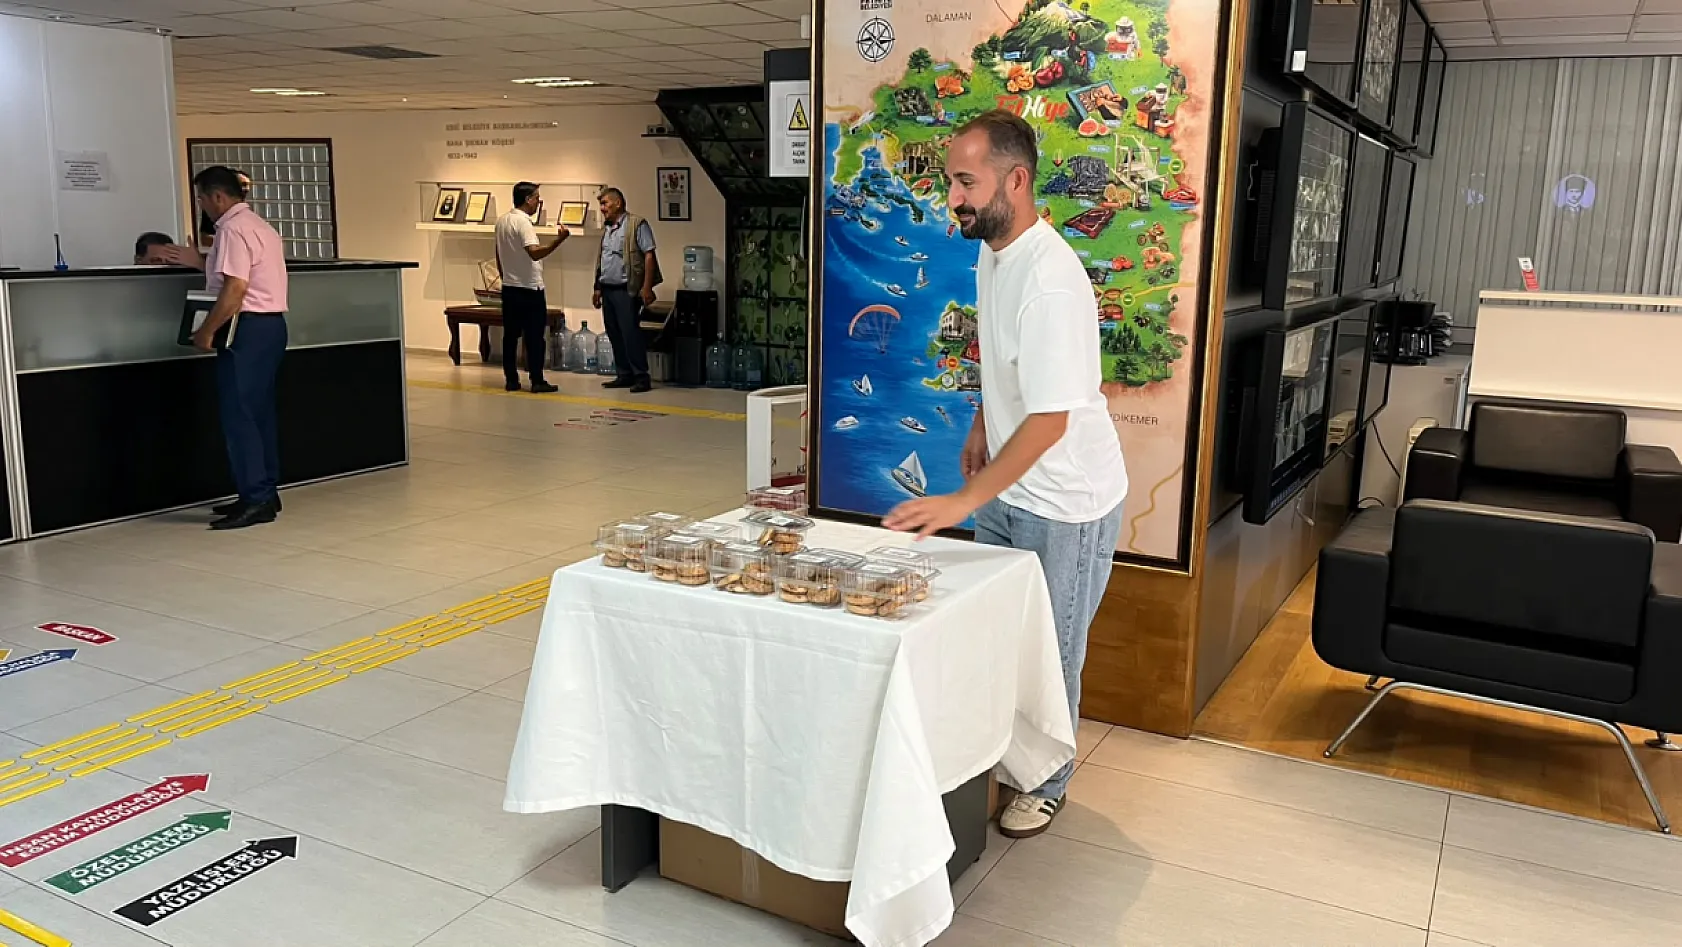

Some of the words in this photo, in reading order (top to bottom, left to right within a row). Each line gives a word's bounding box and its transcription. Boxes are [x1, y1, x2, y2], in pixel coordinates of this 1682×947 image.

[926, 11, 972, 23] DALAMAN
[1109, 412, 1158, 425] DİKEMER
[70, 853, 126, 879] ÖZEL
[125, 822, 194, 854] KALEM
[142, 880, 196, 906] YAZI
